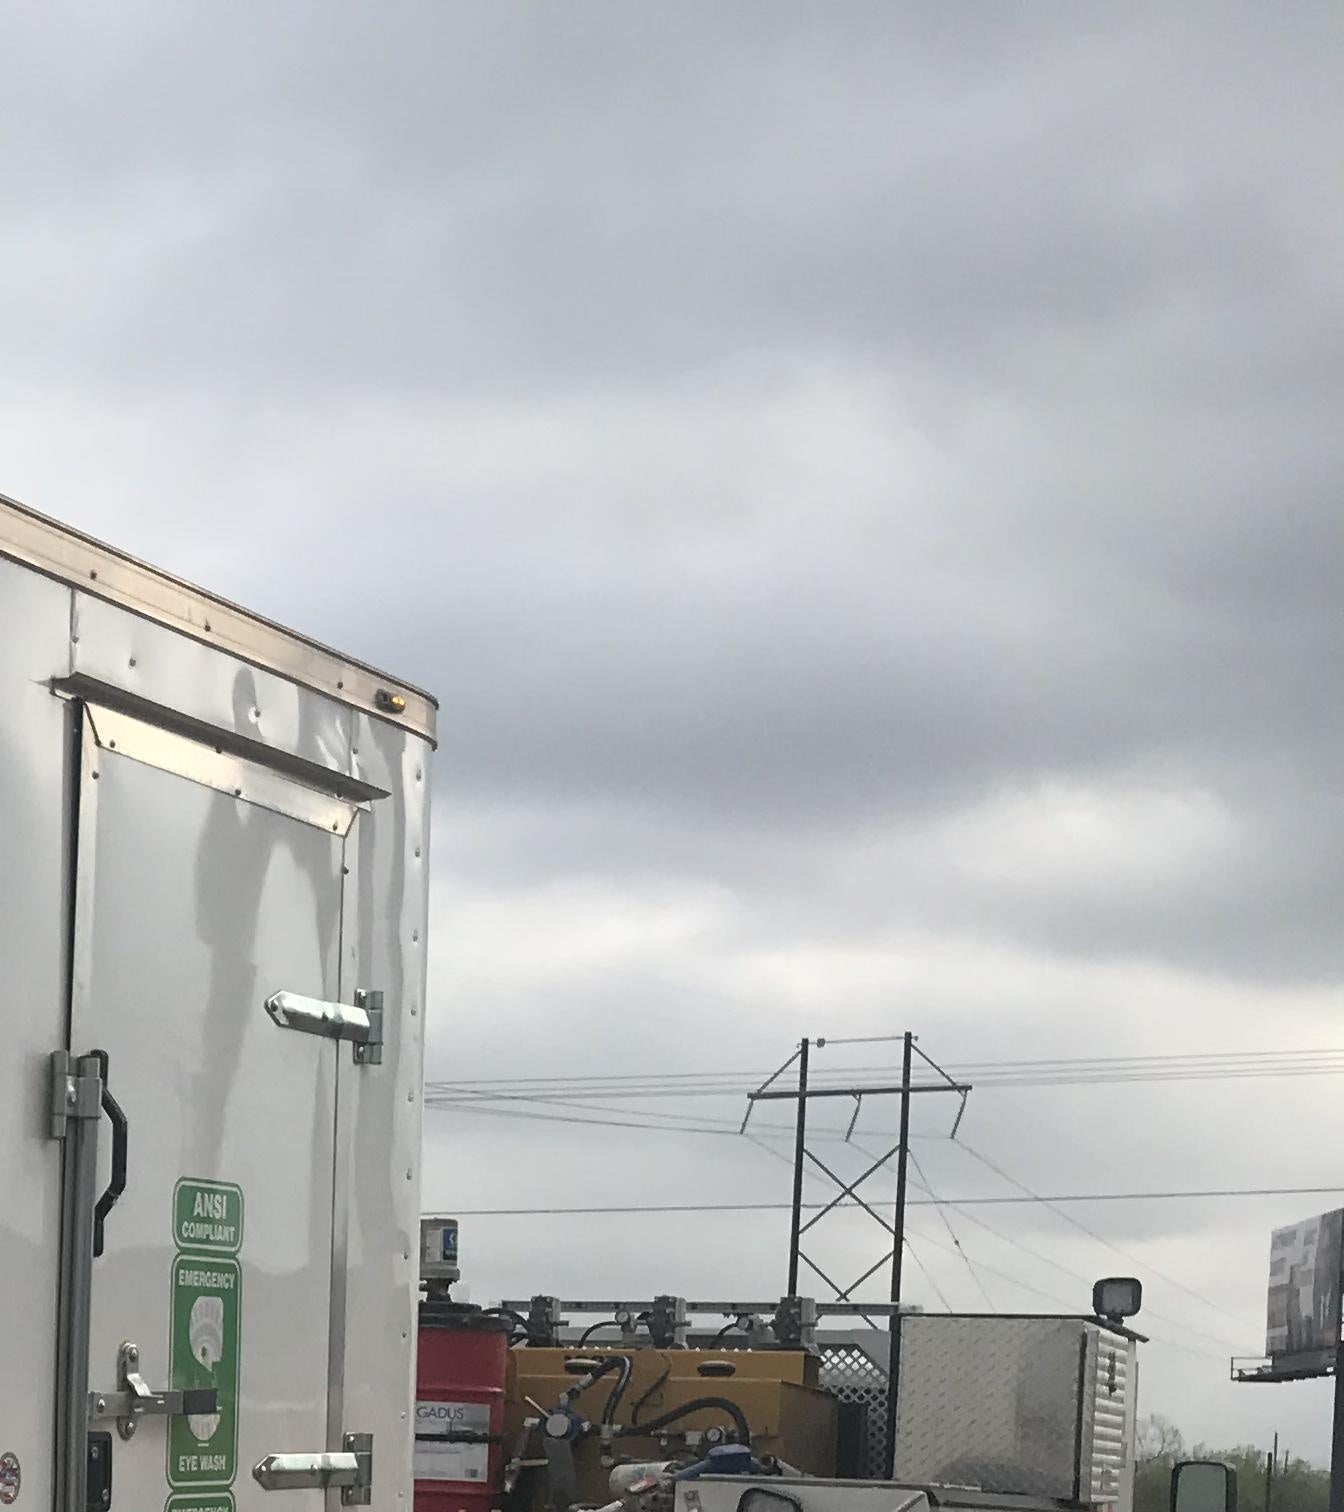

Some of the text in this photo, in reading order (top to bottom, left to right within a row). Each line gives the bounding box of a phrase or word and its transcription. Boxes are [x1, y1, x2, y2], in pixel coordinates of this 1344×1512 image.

[193, 1192, 227, 1219] ANSI
[181, 1221, 235, 1242] COMPLIANT
[178, 1269, 235, 1289] EMERGENCY
[416, 1406, 464, 1419] GADUS
[178, 1454, 226, 1472] EYE WASH
